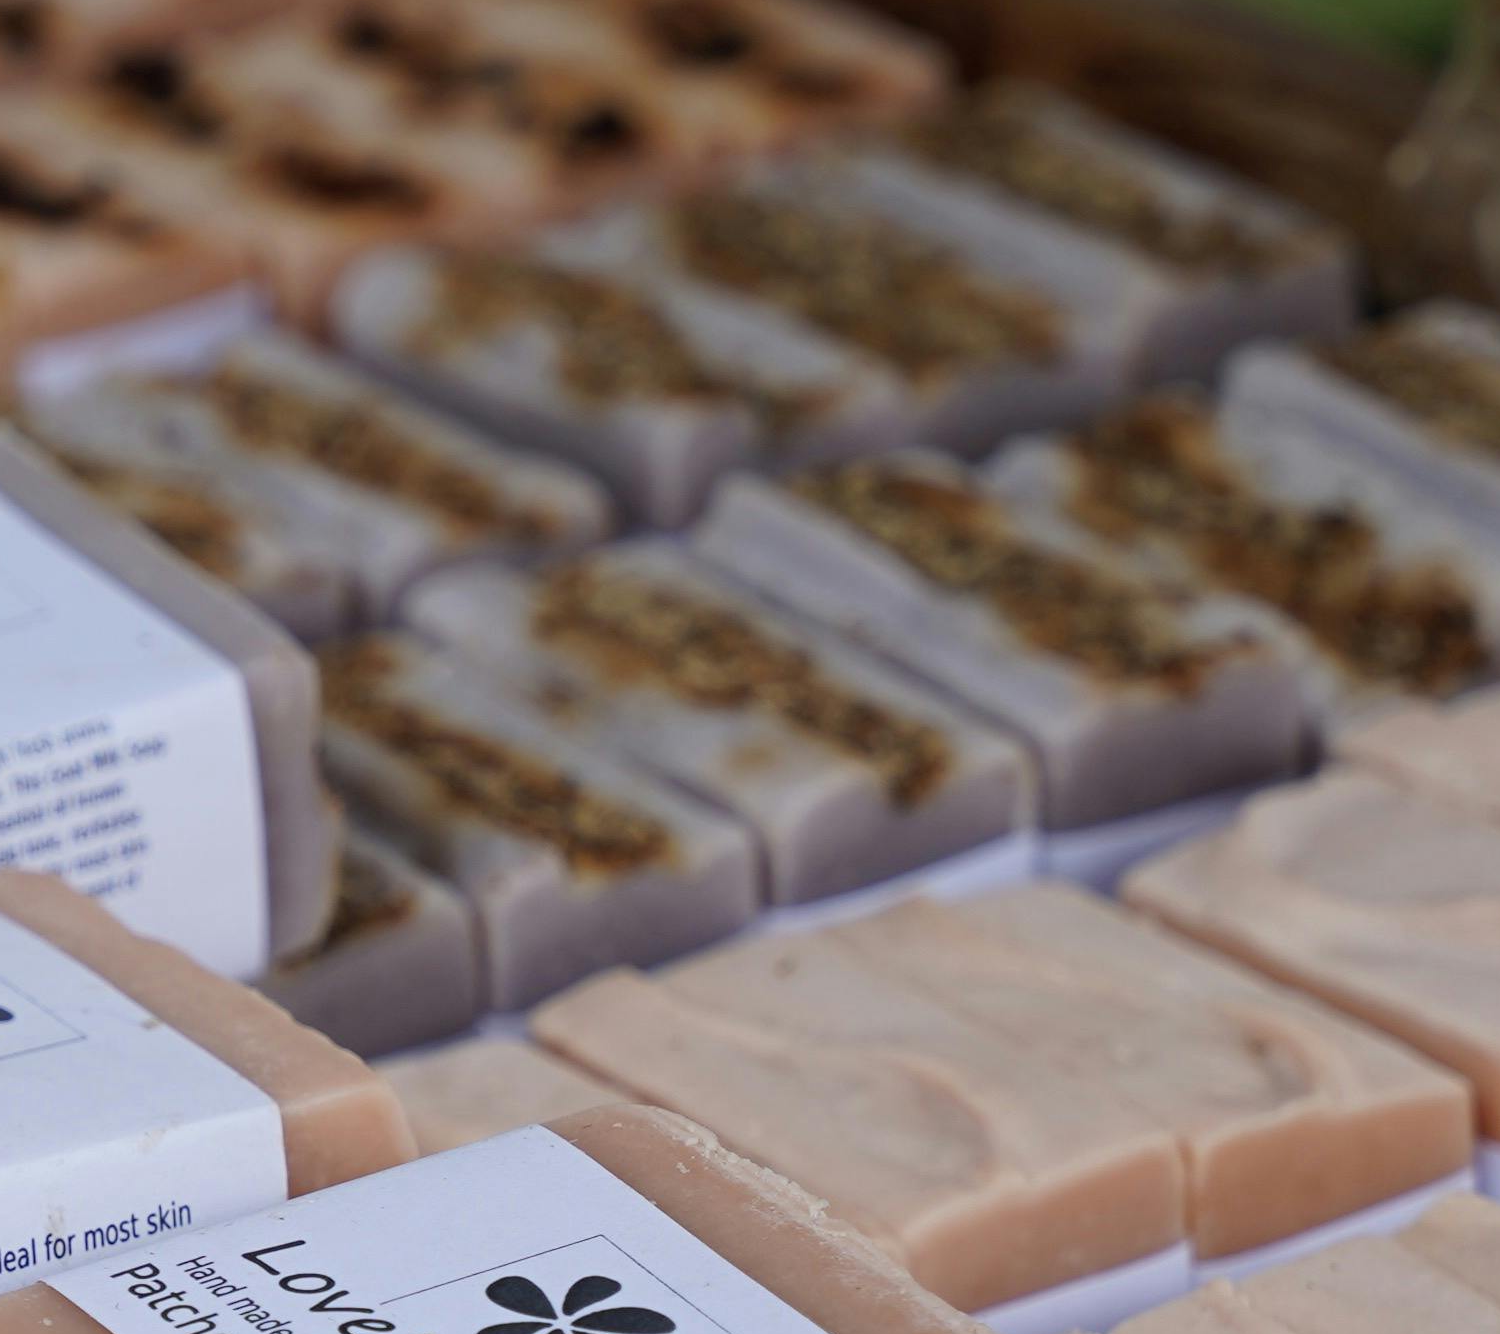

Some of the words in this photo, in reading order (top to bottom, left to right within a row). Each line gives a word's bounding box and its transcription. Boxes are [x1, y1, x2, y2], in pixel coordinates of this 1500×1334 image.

[44, 1233, 77, 1263] for
[83, 1213, 141, 1251] most
[146, 1200, 193, 1236] skin
[175, 1254, 248, 1299] Hand
